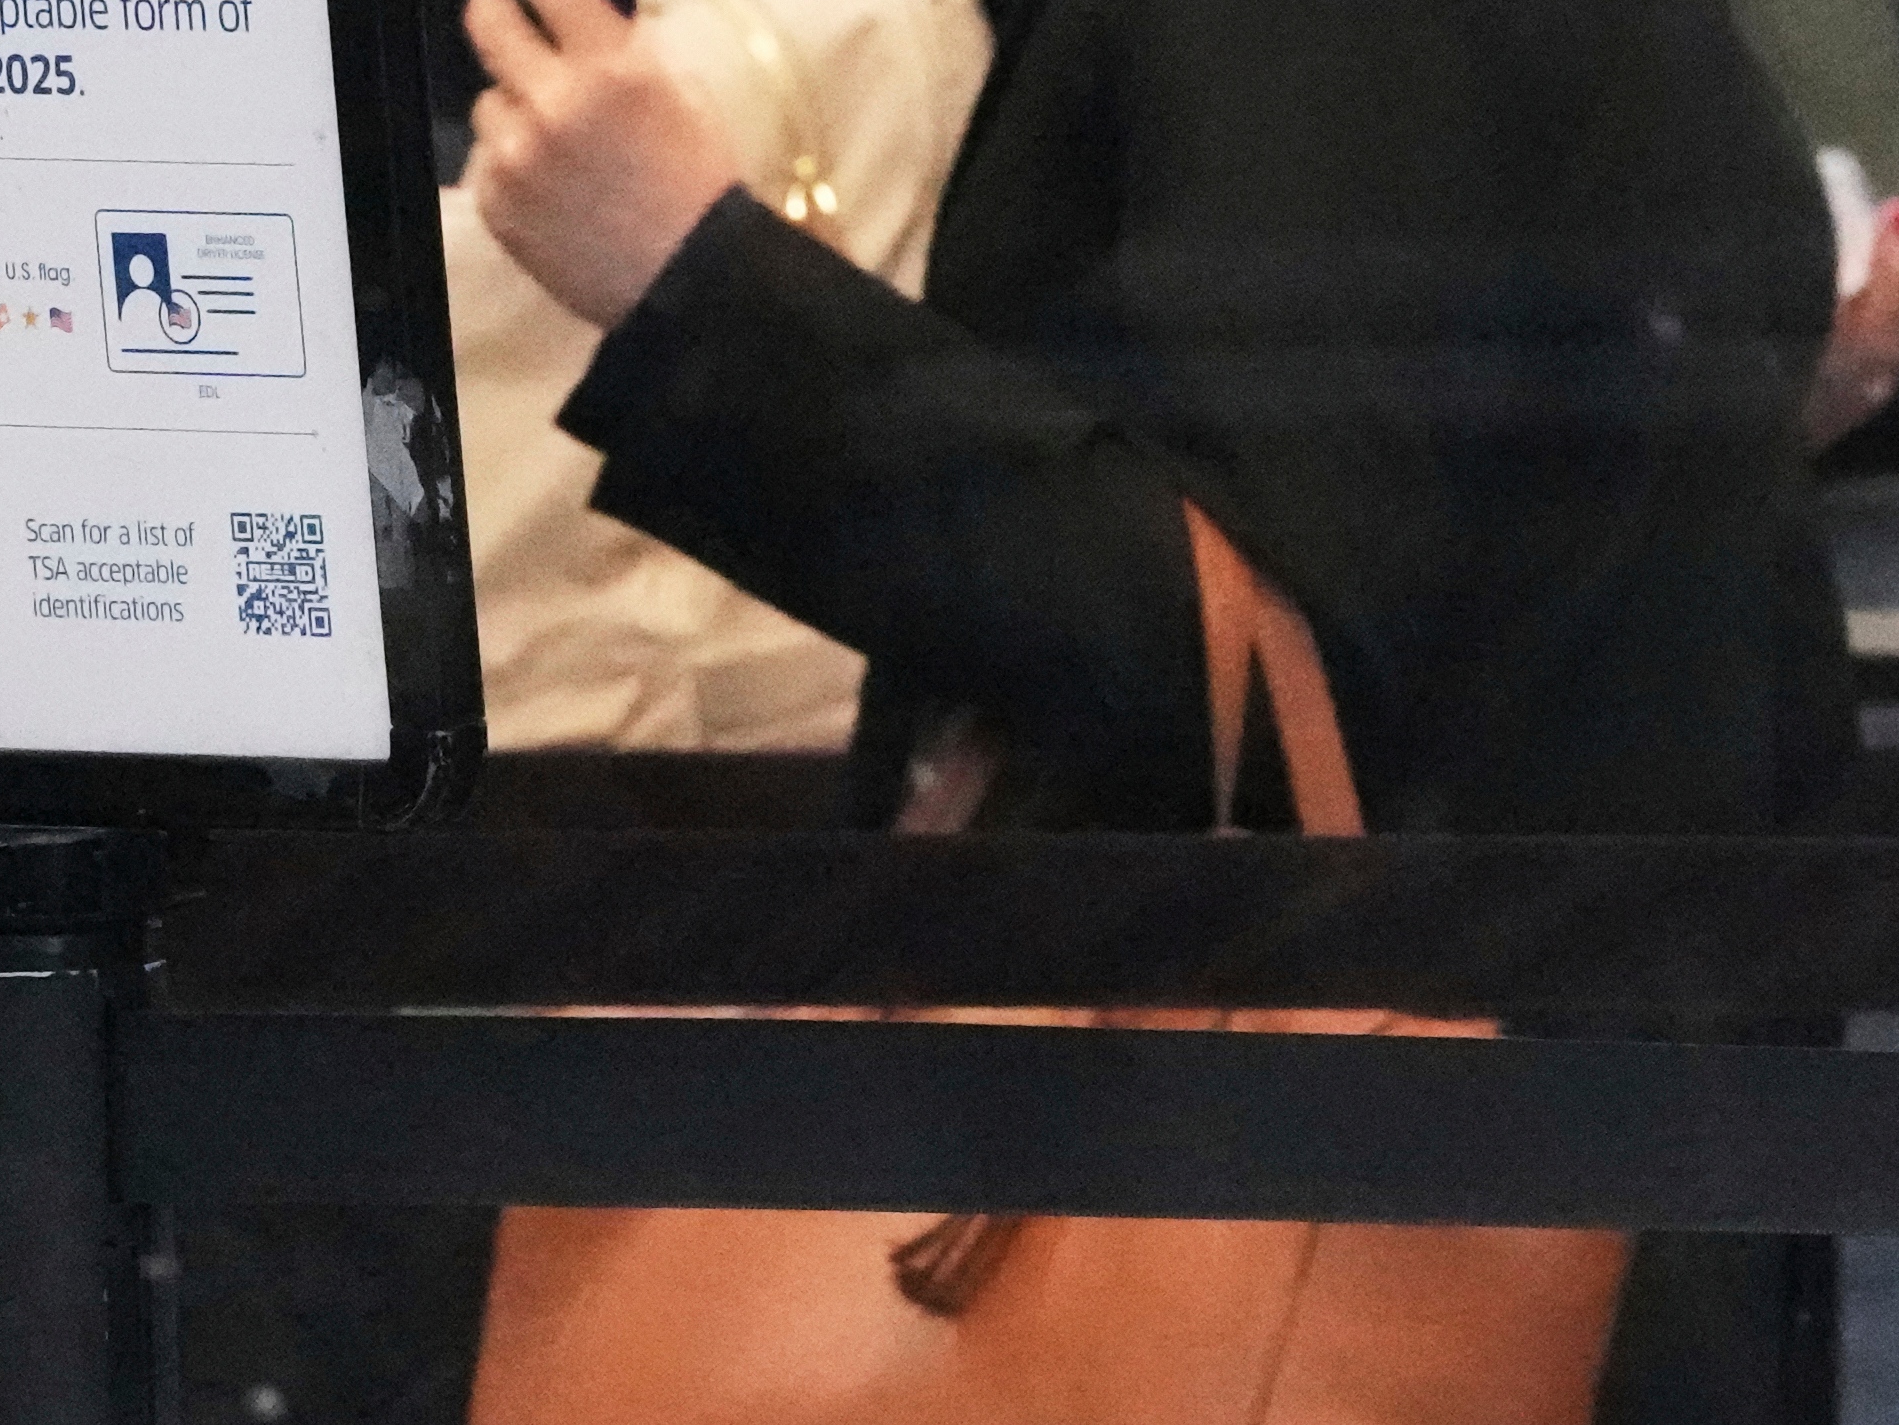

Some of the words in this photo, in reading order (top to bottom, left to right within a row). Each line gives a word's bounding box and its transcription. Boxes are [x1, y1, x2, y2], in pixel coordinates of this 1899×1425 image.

[5, 262, 35, 281] U.S.
[25, 518, 74, 543] Scan
[81, 519, 111, 544] for
[119, 525, 130, 545] a
[137, 521, 168, 546] list
[175, 522, 194, 547] of
[28, 555, 69, 581] TSA
[77, 560, 188, 586] acceptable
[34, 593, 184, 622] identifications
